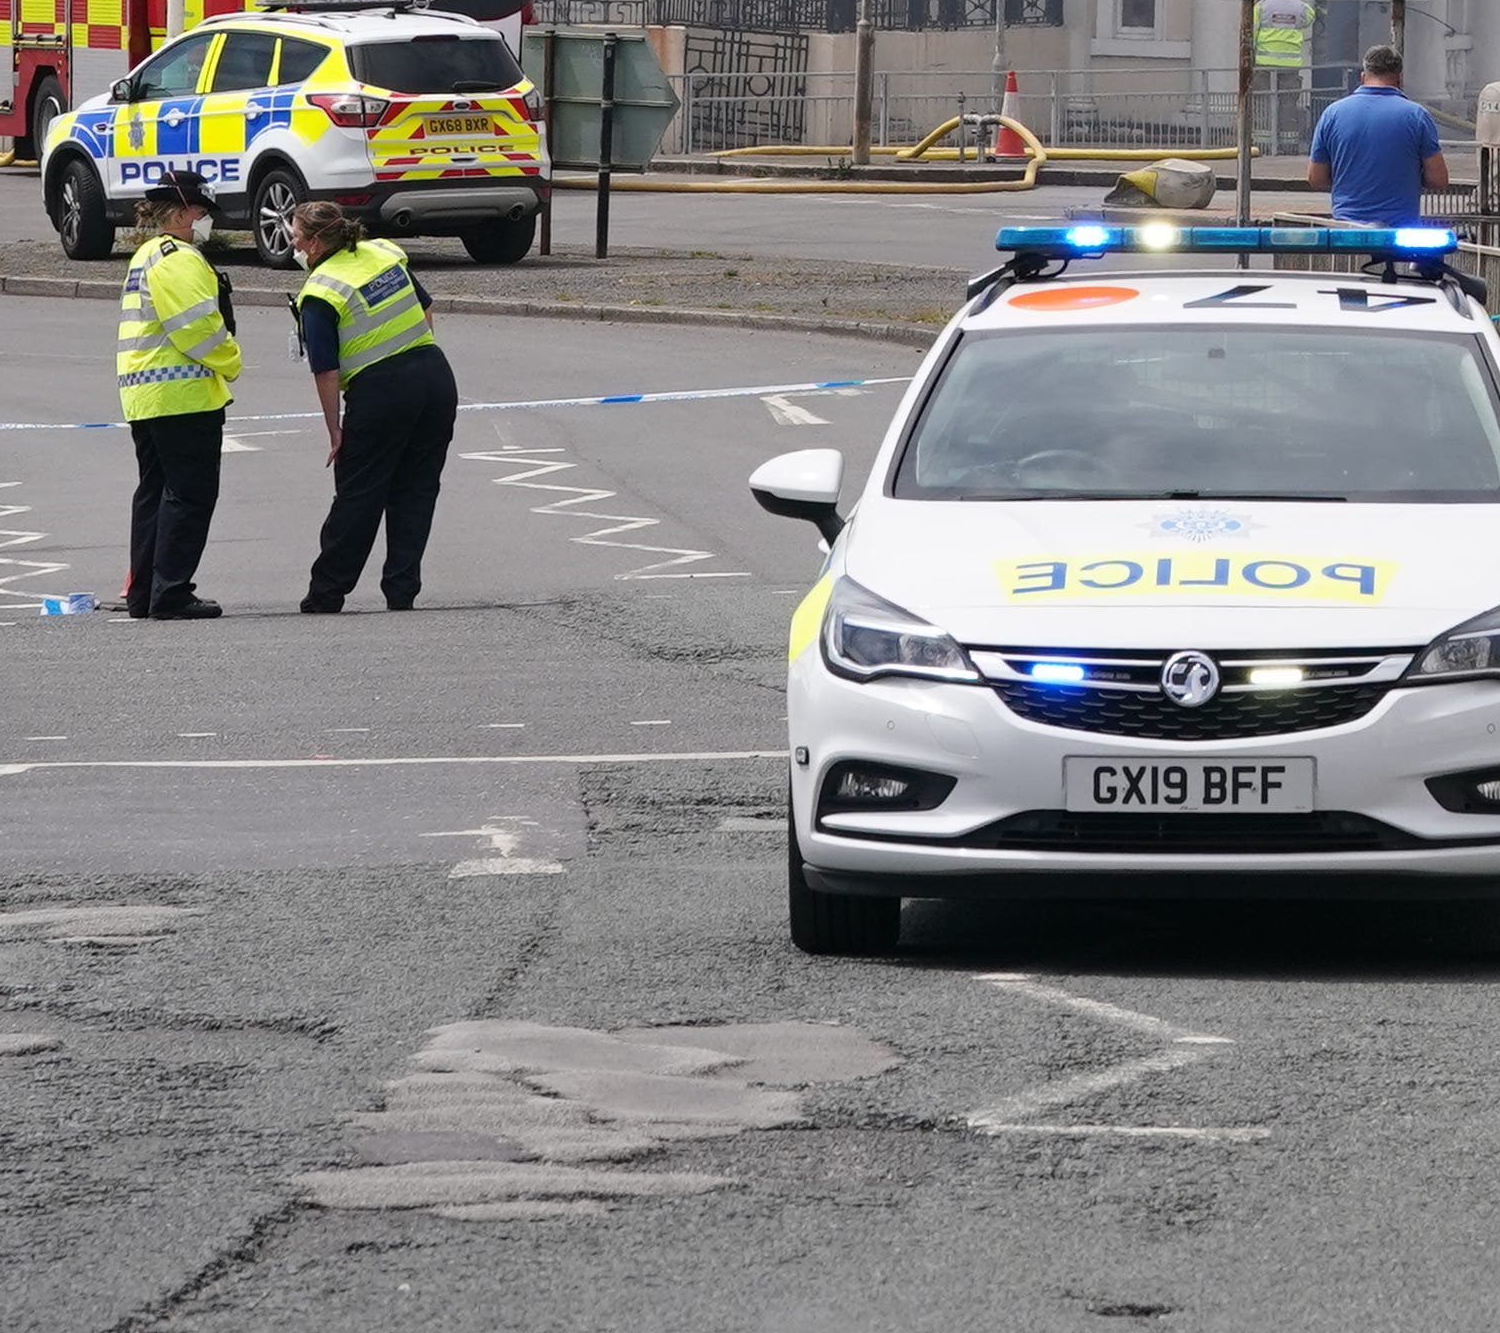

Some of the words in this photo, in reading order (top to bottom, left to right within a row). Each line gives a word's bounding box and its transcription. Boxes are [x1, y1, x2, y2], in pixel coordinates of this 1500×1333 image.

[429, 119, 462, 133] GX68
[465, 117, 489, 132] BXR
[409, 144, 515, 156] POLICE
[368, 269, 398, 292] POLICE
[1093, 765, 1188, 805] GX19
[1202, 765, 1286, 805] BFF
